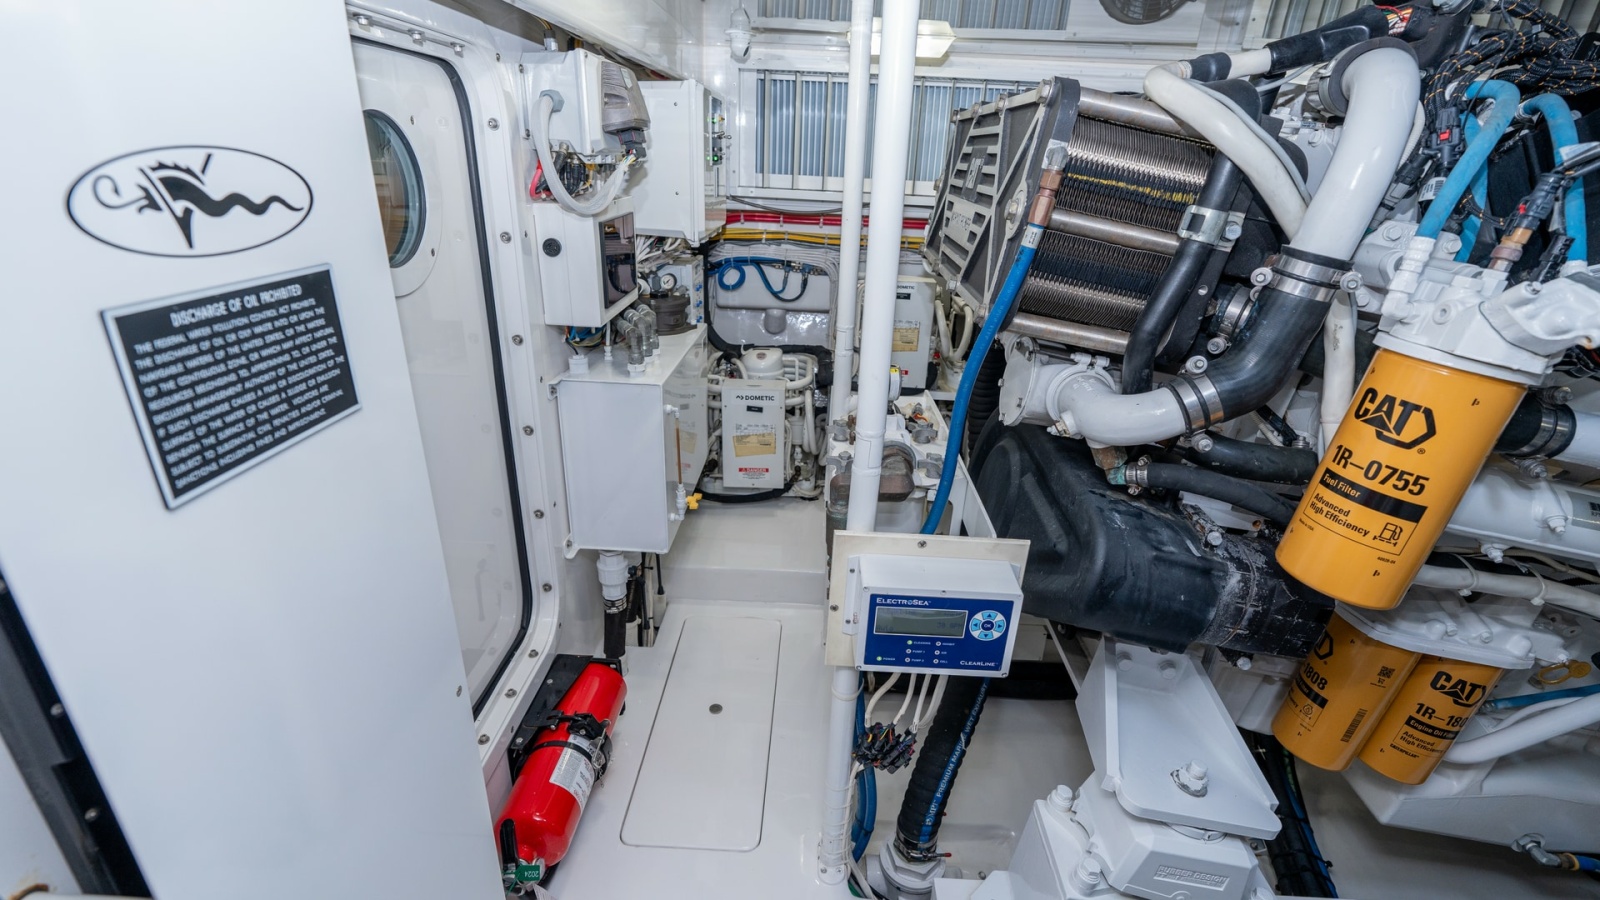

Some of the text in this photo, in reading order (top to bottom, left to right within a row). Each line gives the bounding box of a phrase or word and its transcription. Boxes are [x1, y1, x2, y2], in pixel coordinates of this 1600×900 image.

[169, 284, 302, 327] DISCHARGE OF OIL PROHIBITED
[1354, 387, 1422, 436] CAT
[1332, 444, 1431, 496] 1R-0755
[1322, 473, 1361, 498] Fuel Filter
[1314, 492, 1351, 517] Advanced
[1309, 502, 1370, 537] High Efficiency
[1430, 671, 1486, 702] CAT
[936, 763, 955, 798] PREMIUM
[965, 715, 976, 733] WET
[971, 682, 988, 715] EXHAUST
[1402, 731, 1435, 746] Advanced
[1409, 719, 1433, 733] Engine
[1433, 728, 1443, 736] Oil
[1400, 735, 1416, 746] High
[524, 870, 539, 878] 2024
[1193, 872, 1228, 884] DESIGN
